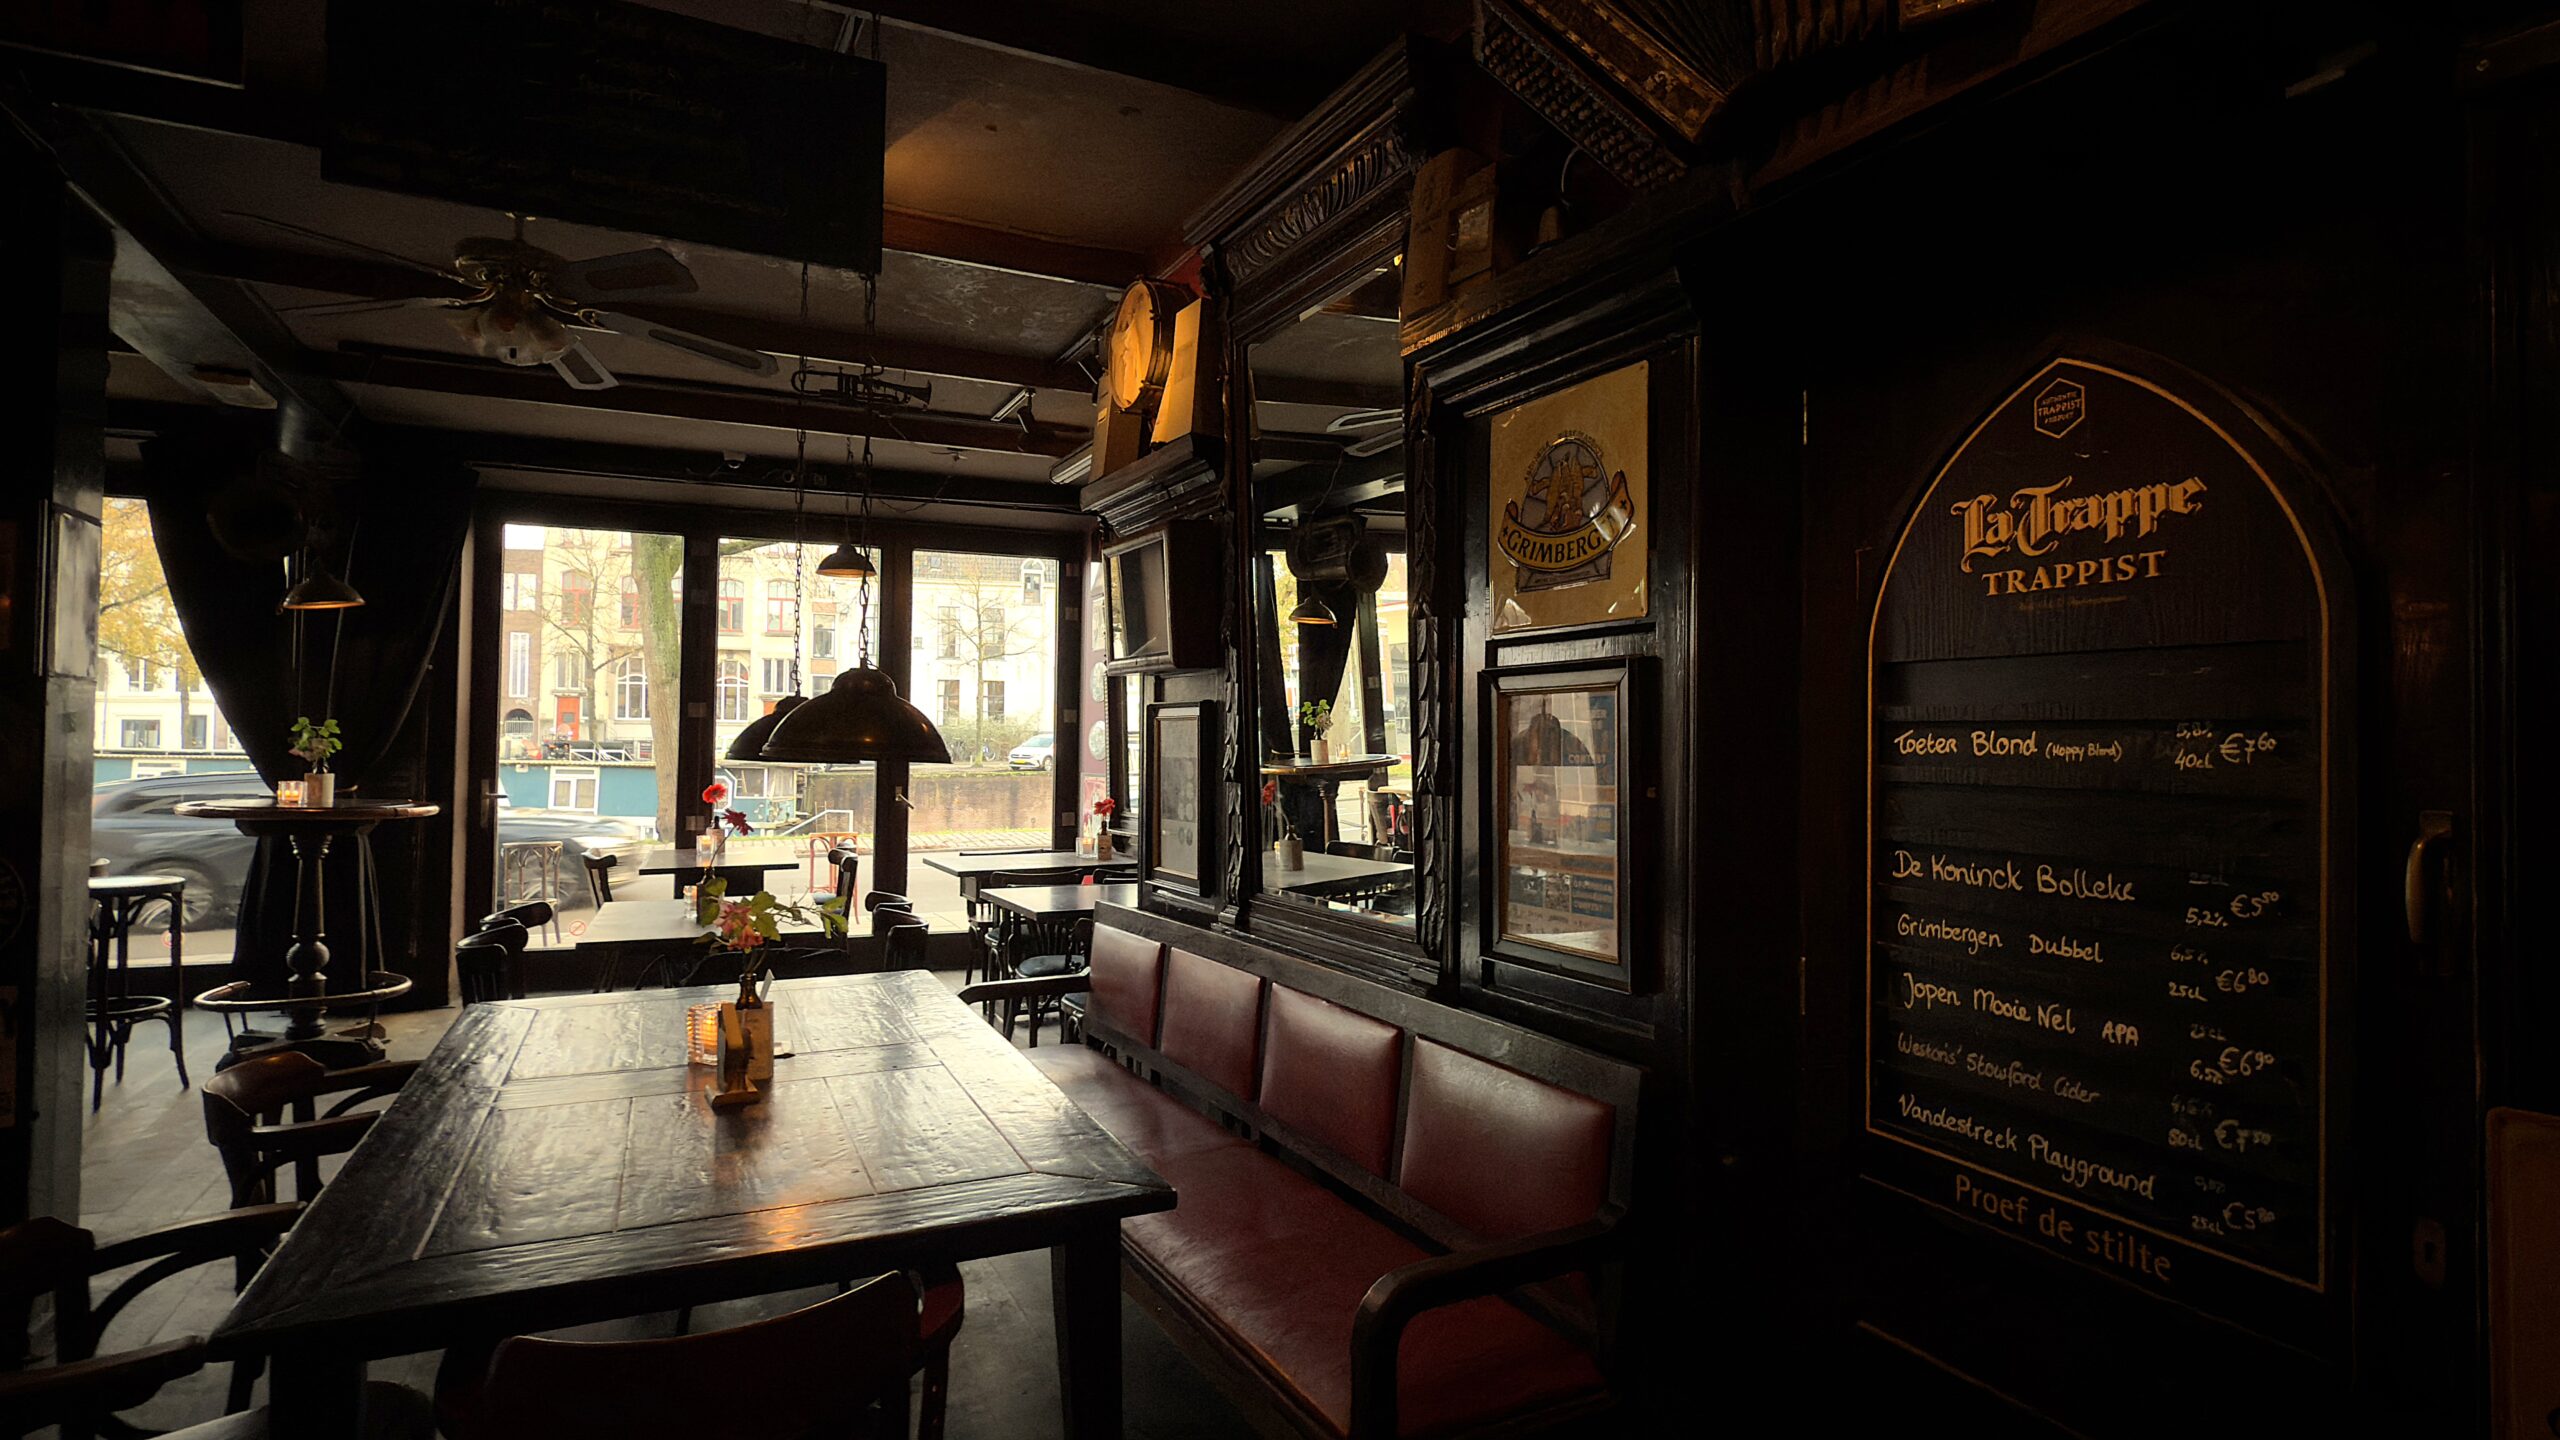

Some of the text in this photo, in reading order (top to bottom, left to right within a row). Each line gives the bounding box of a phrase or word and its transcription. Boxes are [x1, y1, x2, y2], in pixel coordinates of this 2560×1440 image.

[2037, 398, 2082, 416] TRAPPIST
[1507, 512, 1617, 564] GRIMBERGN
[1950, 475, 2208, 574] La Trappe
[1981, 549, 2170, 597] TRAPPIST
[1971, 729, 2038, 757] Blond
[2174, 748, 2214, 771] 40cl
[1892, 849, 2136, 902] De Koninck Bolleke
[1897, 913, 2104, 964] Grimbergen Dubbel
[1903, 971, 2140, 1048] Jopen Mooie Nel APA
[1966, 1052, 2044, 1091] Stowford
[2054, 1076, 2101, 1104] Cider
[1898, 1092, 2157, 1200] Vandestreek Playground
[1954, 1174, 2173, 1282] Proef de stilte
